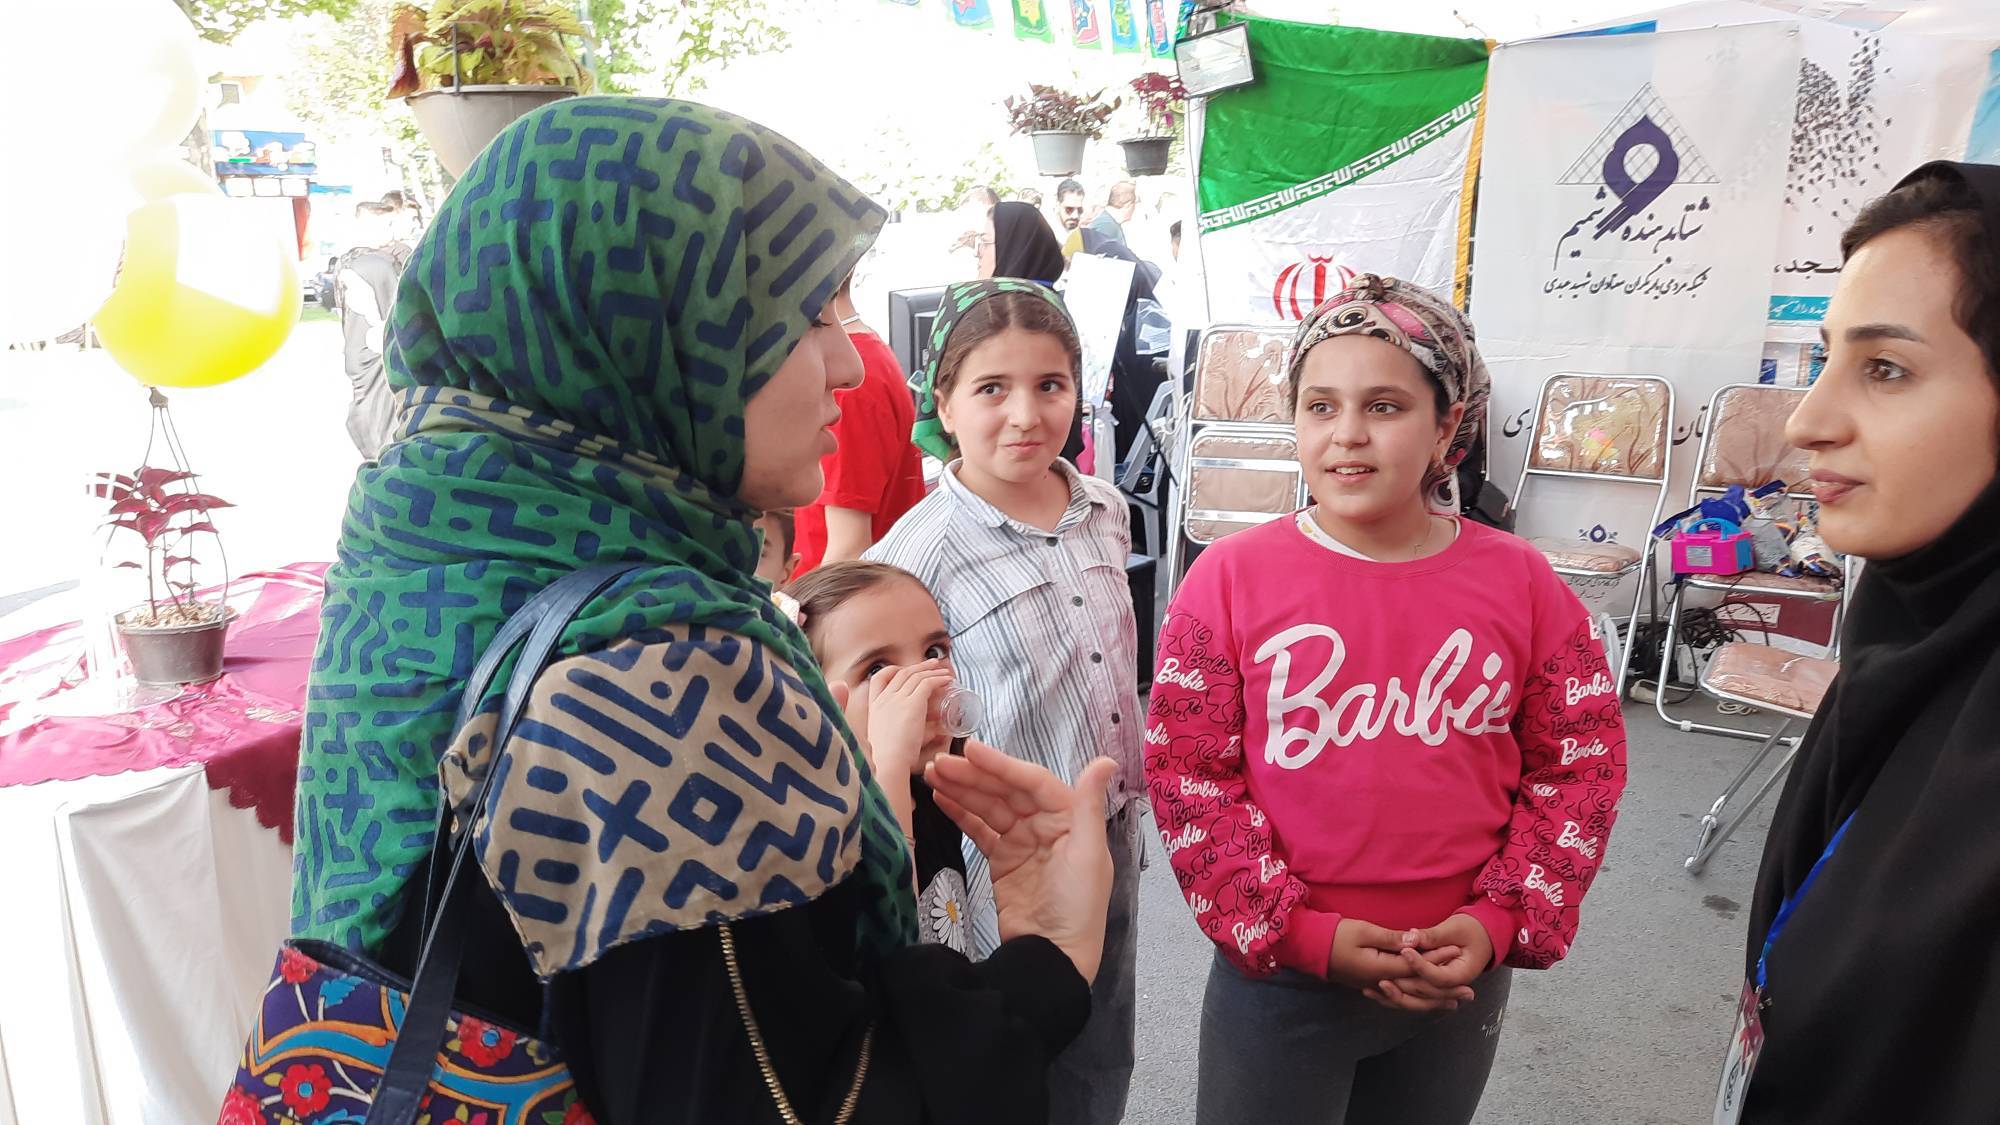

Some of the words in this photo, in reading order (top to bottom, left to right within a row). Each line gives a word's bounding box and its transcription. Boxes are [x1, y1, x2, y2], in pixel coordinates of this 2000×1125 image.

[1156, 658, 1207, 691] Barbie
[1565, 672, 1614, 706] Barbie
[1254, 623, 1512, 770] Barbie
[1179, 776, 1223, 798] Barbie
[1159, 822, 1207, 858] Barbie
[1557, 821, 1597, 859] Barbie
[1524, 864, 1564, 906] Barbie
